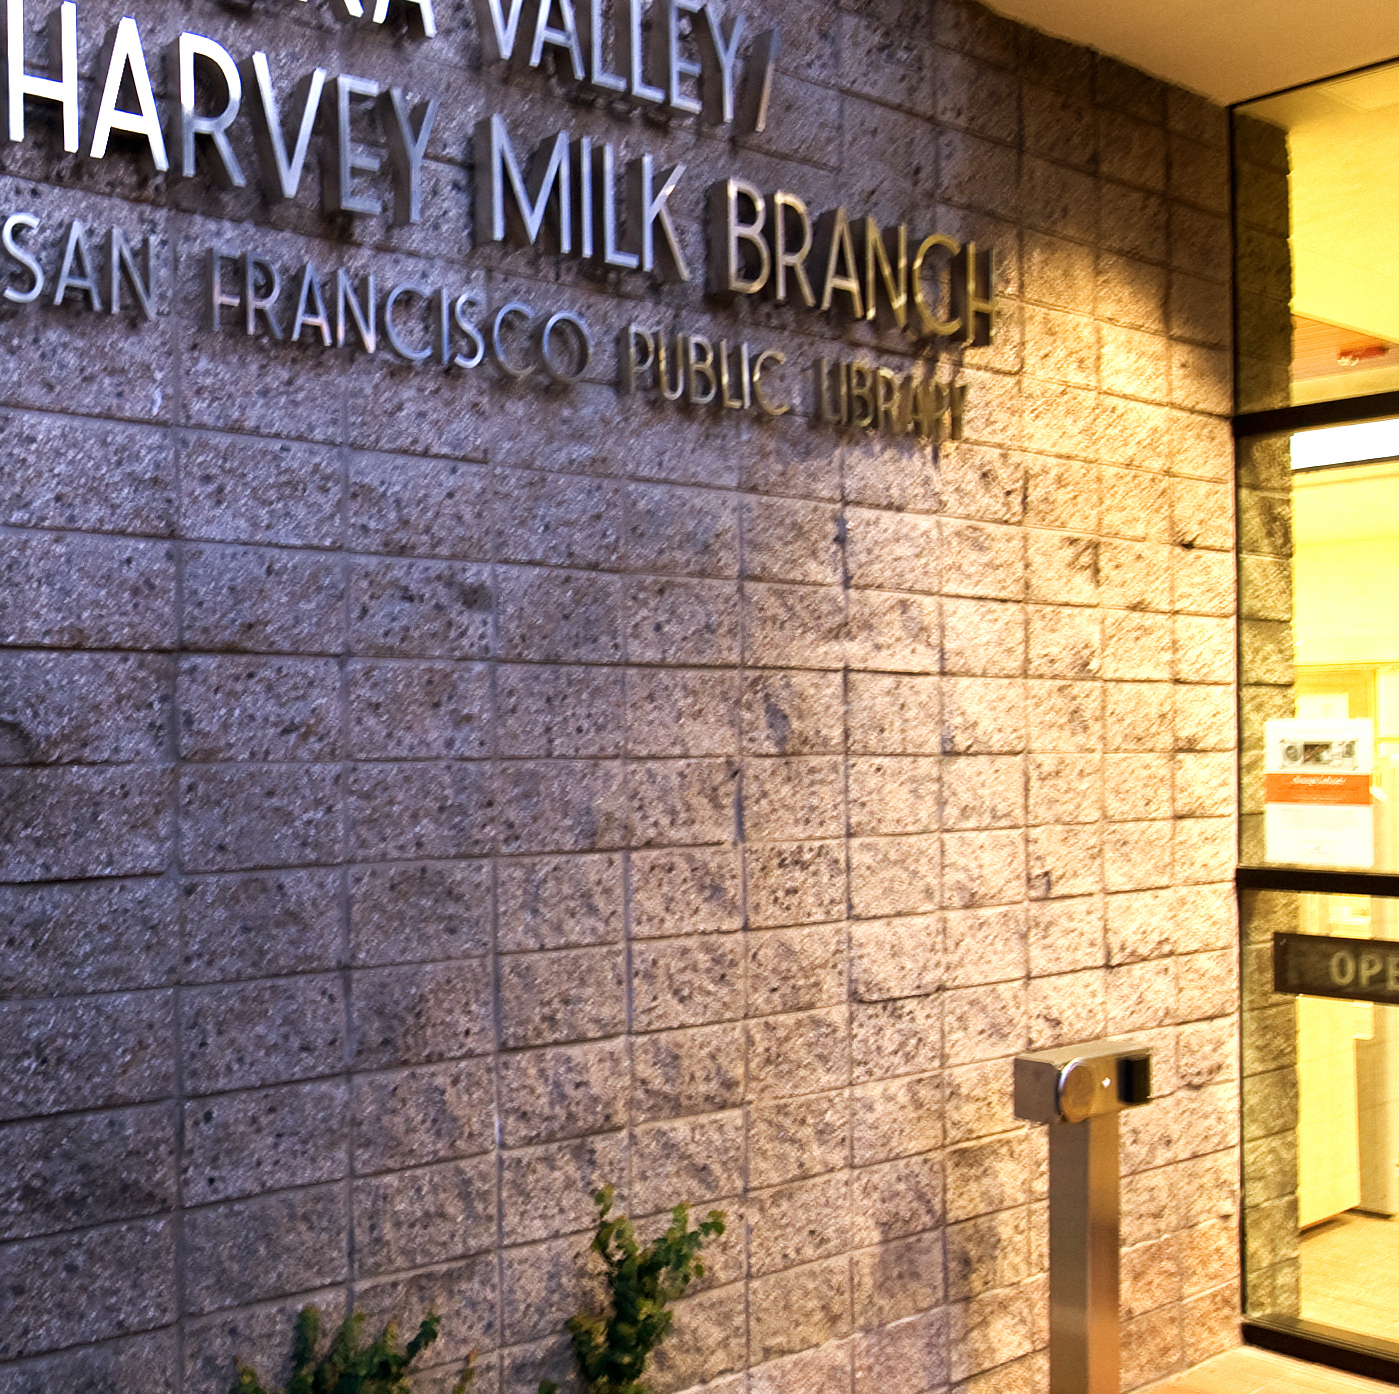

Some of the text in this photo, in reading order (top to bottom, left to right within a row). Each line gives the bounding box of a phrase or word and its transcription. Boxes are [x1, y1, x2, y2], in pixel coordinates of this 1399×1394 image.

[1, 211, 157, 322] SAN
[211, 246, 594, 382] FRANCISCO
[627, 321, 791, 417] PUBLIC
[489, 111, 692, 282] MILK
[726, 175, 1000, 348] BRANCH
